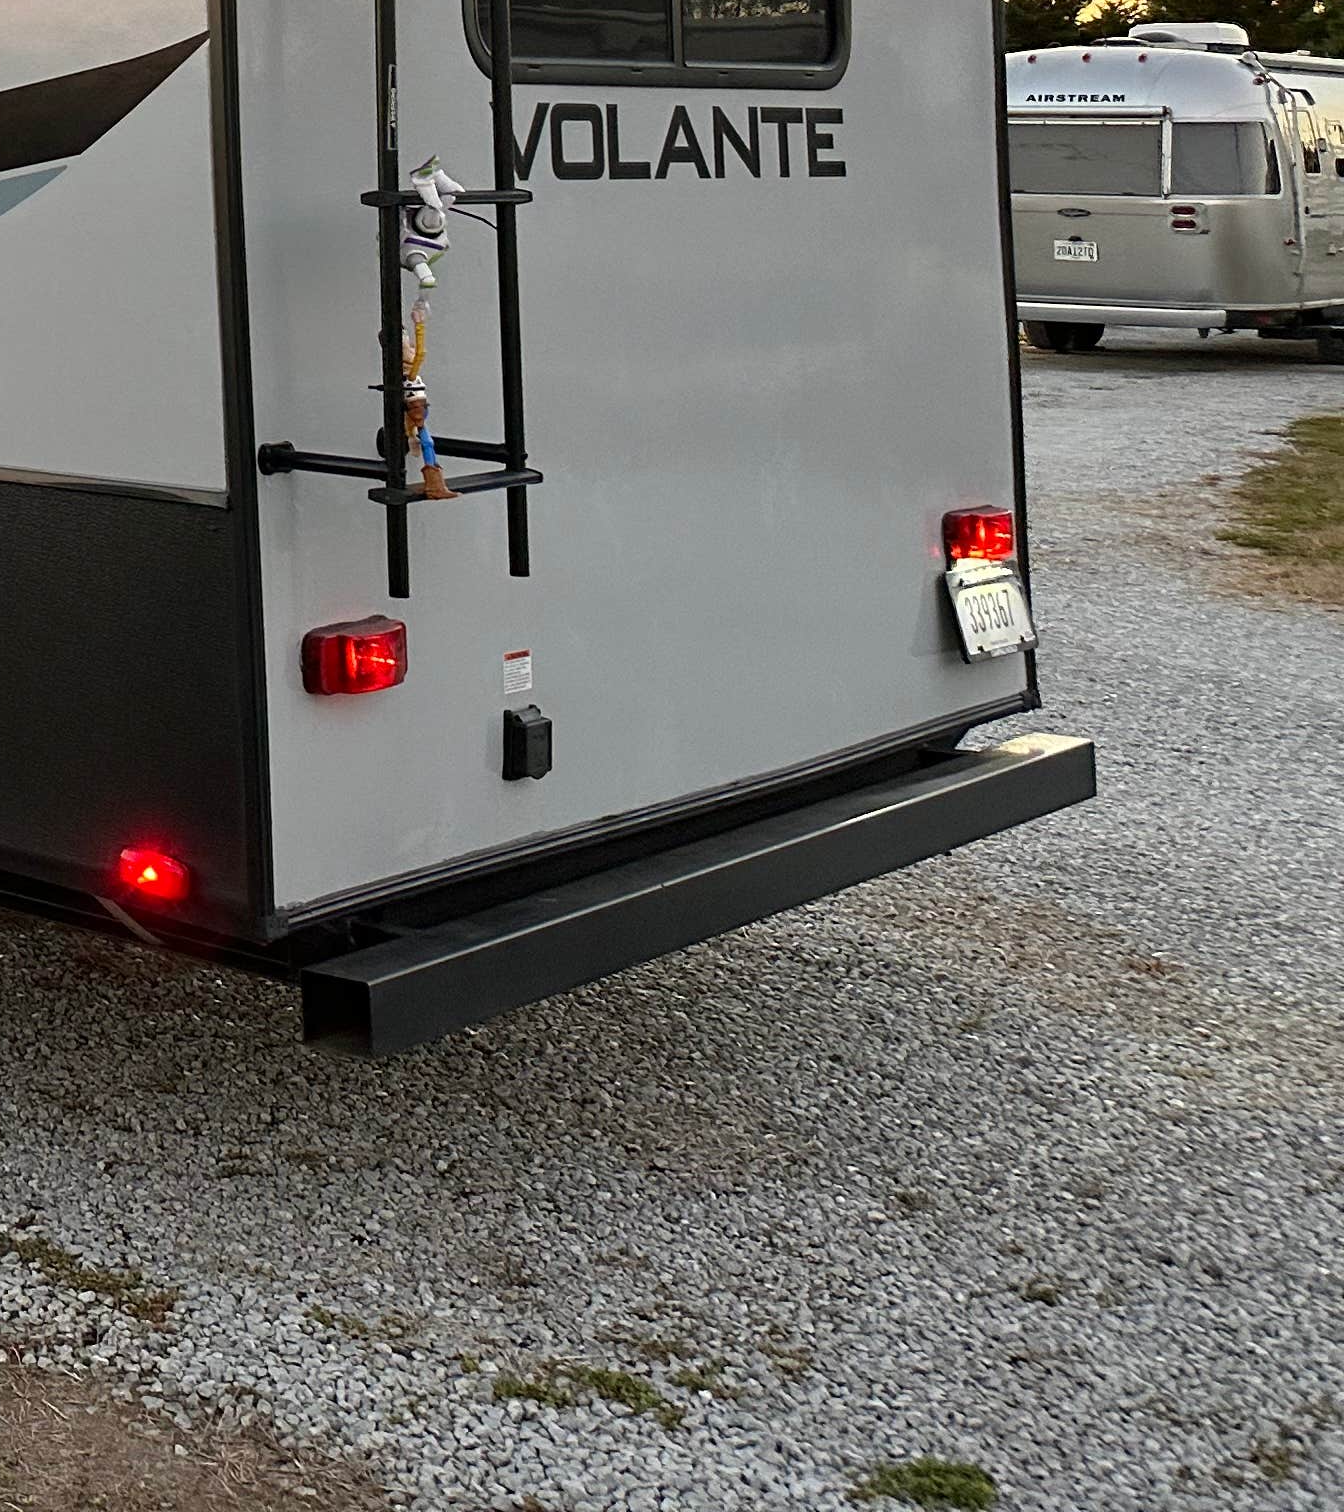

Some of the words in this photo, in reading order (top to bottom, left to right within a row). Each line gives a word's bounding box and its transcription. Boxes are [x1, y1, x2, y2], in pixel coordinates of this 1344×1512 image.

[1025, 94, 1126, 103] AIRSTREAM
[490, 102, 847, 181] VOLANTE
[964, 588, 1015, 633] 339367
